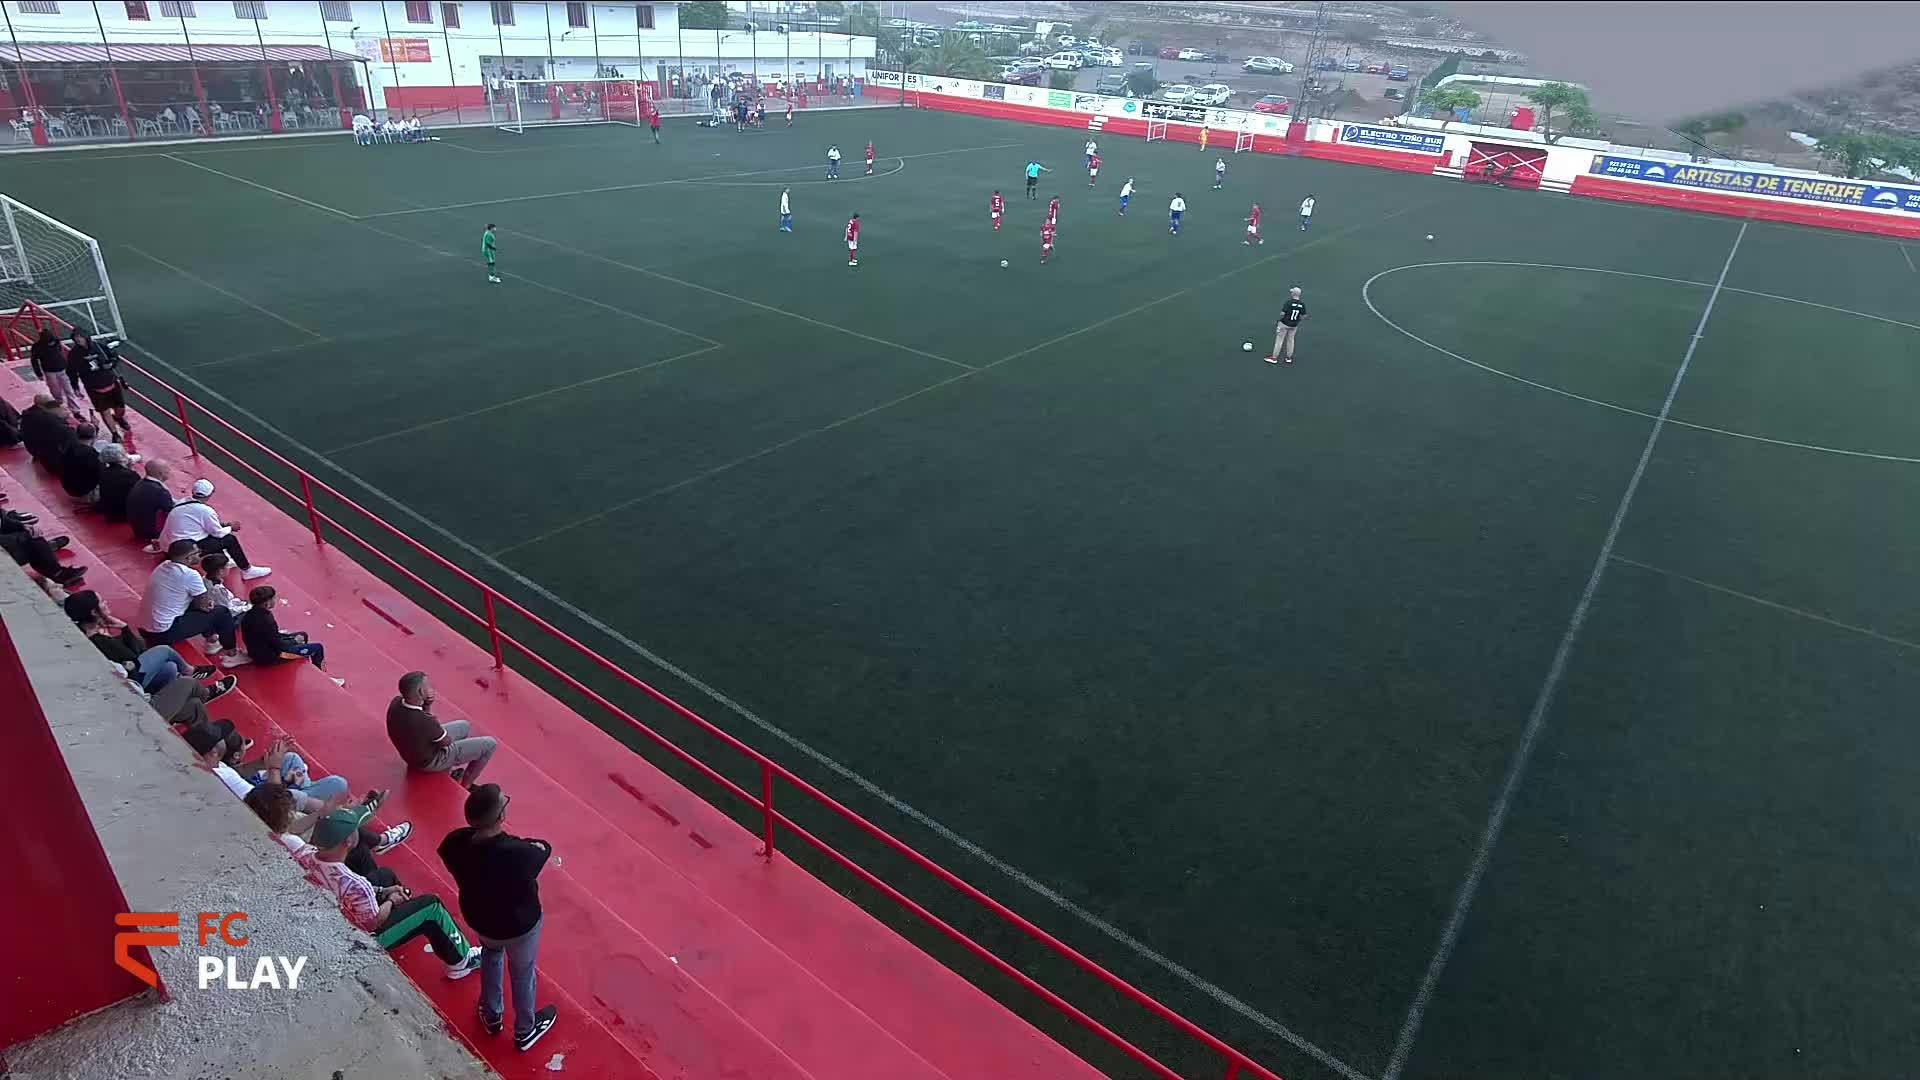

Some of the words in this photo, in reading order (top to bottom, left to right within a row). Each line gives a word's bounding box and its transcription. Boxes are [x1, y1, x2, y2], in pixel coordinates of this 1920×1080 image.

[872, 71, 917, 83] UNIFORES
[1360, 129, 1398, 139] ELECTRO
[1425, 137, 1443, 145] SUR
[1673, 167, 1754, 187] ARTISTAS
[1756, 176, 1780, 190] DE
[1783, 178, 1866, 200] TENERIFE
